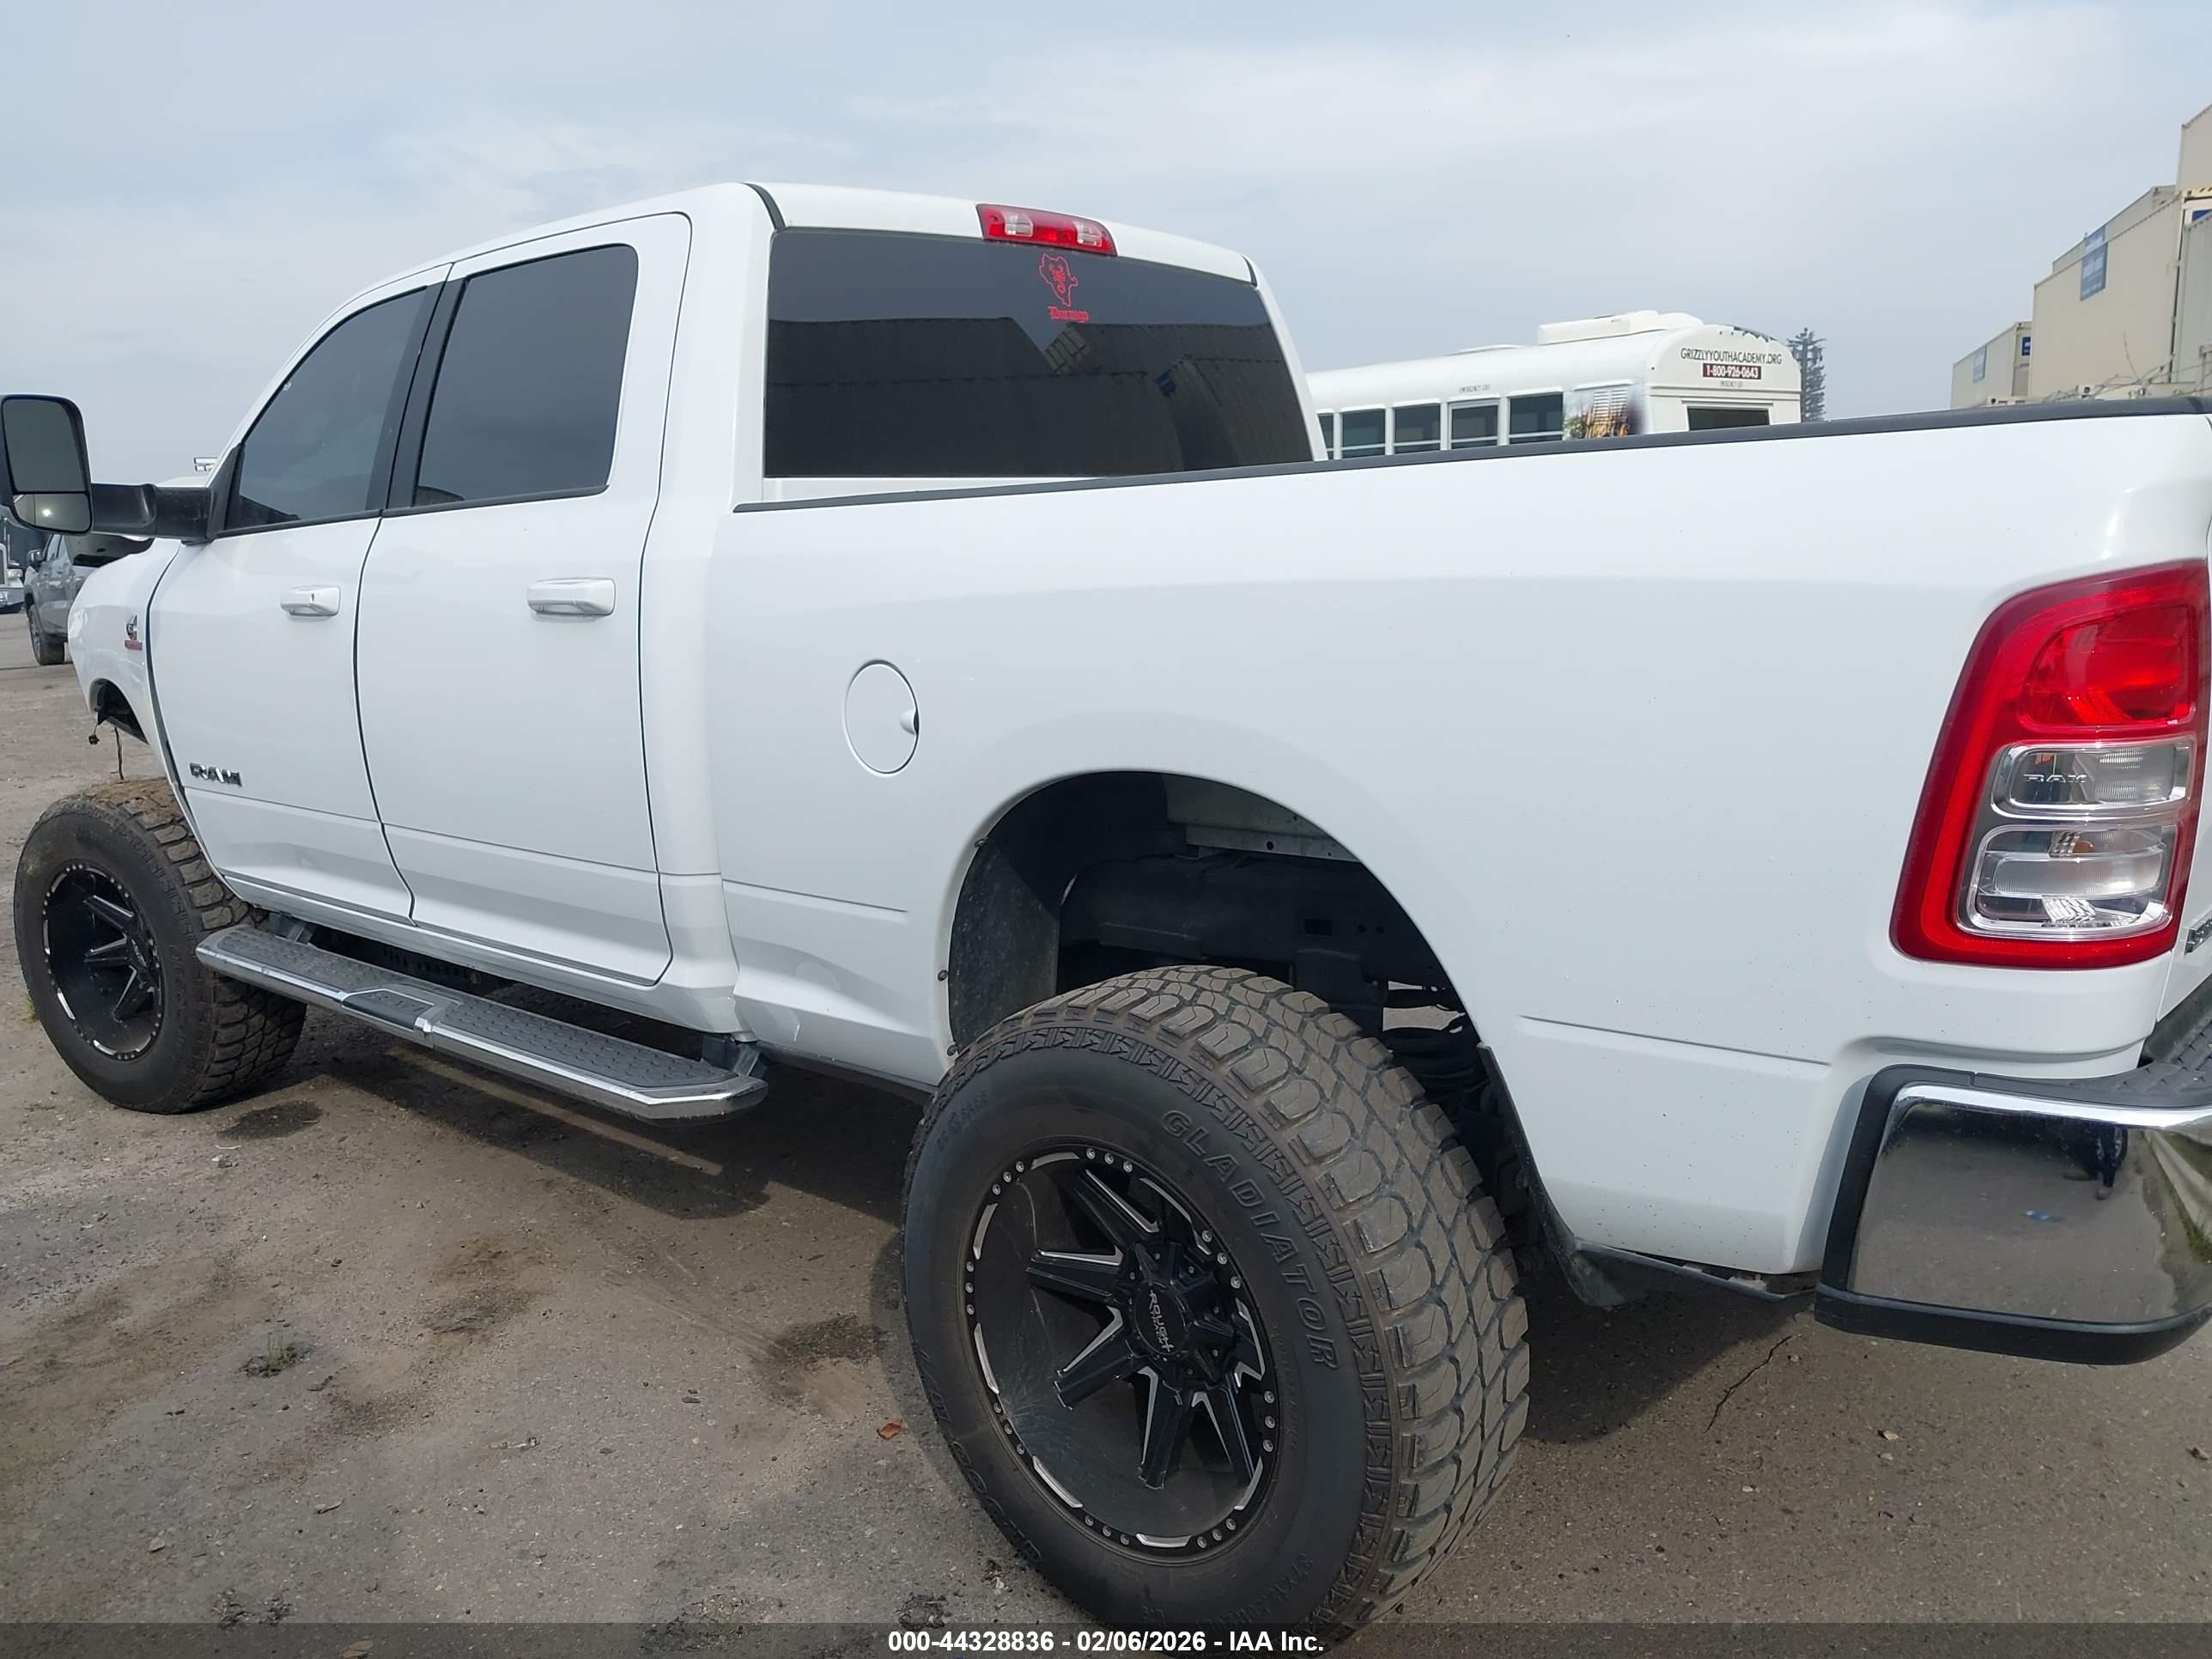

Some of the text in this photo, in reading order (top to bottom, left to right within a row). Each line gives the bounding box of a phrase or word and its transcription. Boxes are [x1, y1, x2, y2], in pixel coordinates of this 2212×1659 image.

[1681, 348, 1782, 364] GRIZZLYYOUTHACADEMY.ORG
[1705, 365, 1758, 378] 1-800-926-0643
[1163, 1110, 1340, 1370] GLADIATOR
